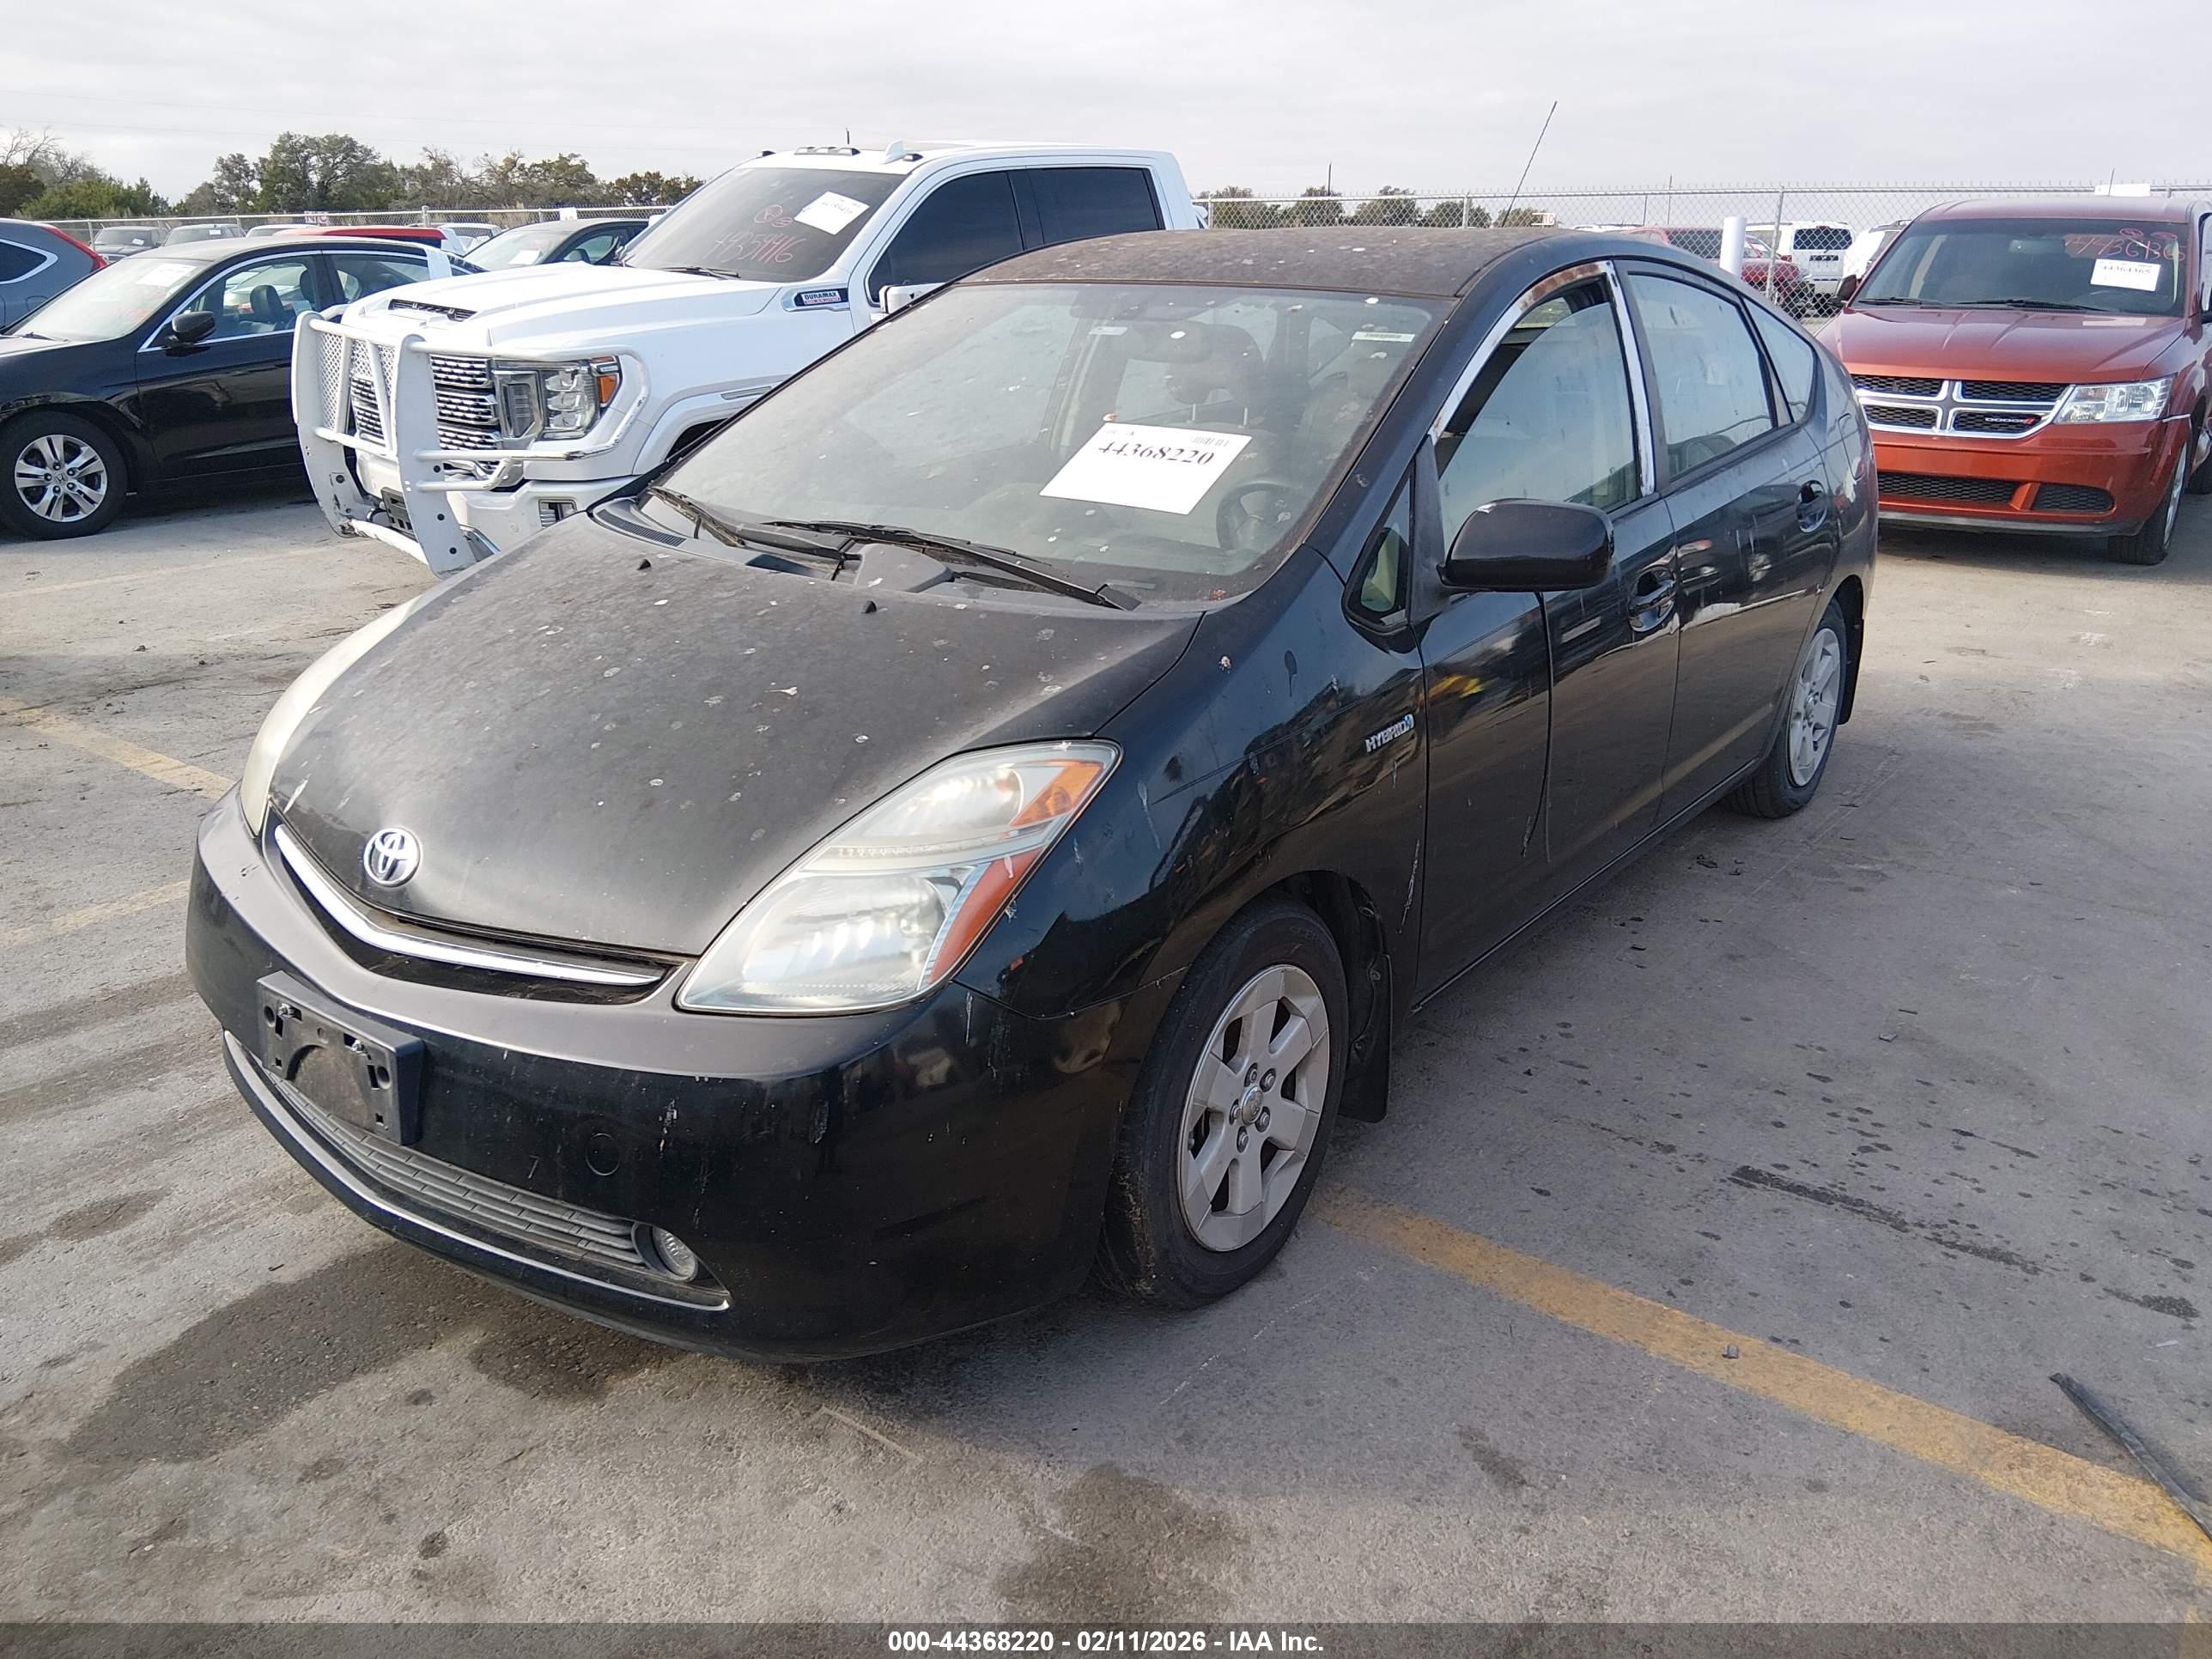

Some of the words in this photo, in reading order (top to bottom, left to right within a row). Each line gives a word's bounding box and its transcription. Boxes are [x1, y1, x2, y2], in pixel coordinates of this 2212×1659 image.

[804, 292, 837, 301] DURAMAX
[1098, 441, 1215, 465] 44368220
[1364, 720, 1409, 753] HYBRID
